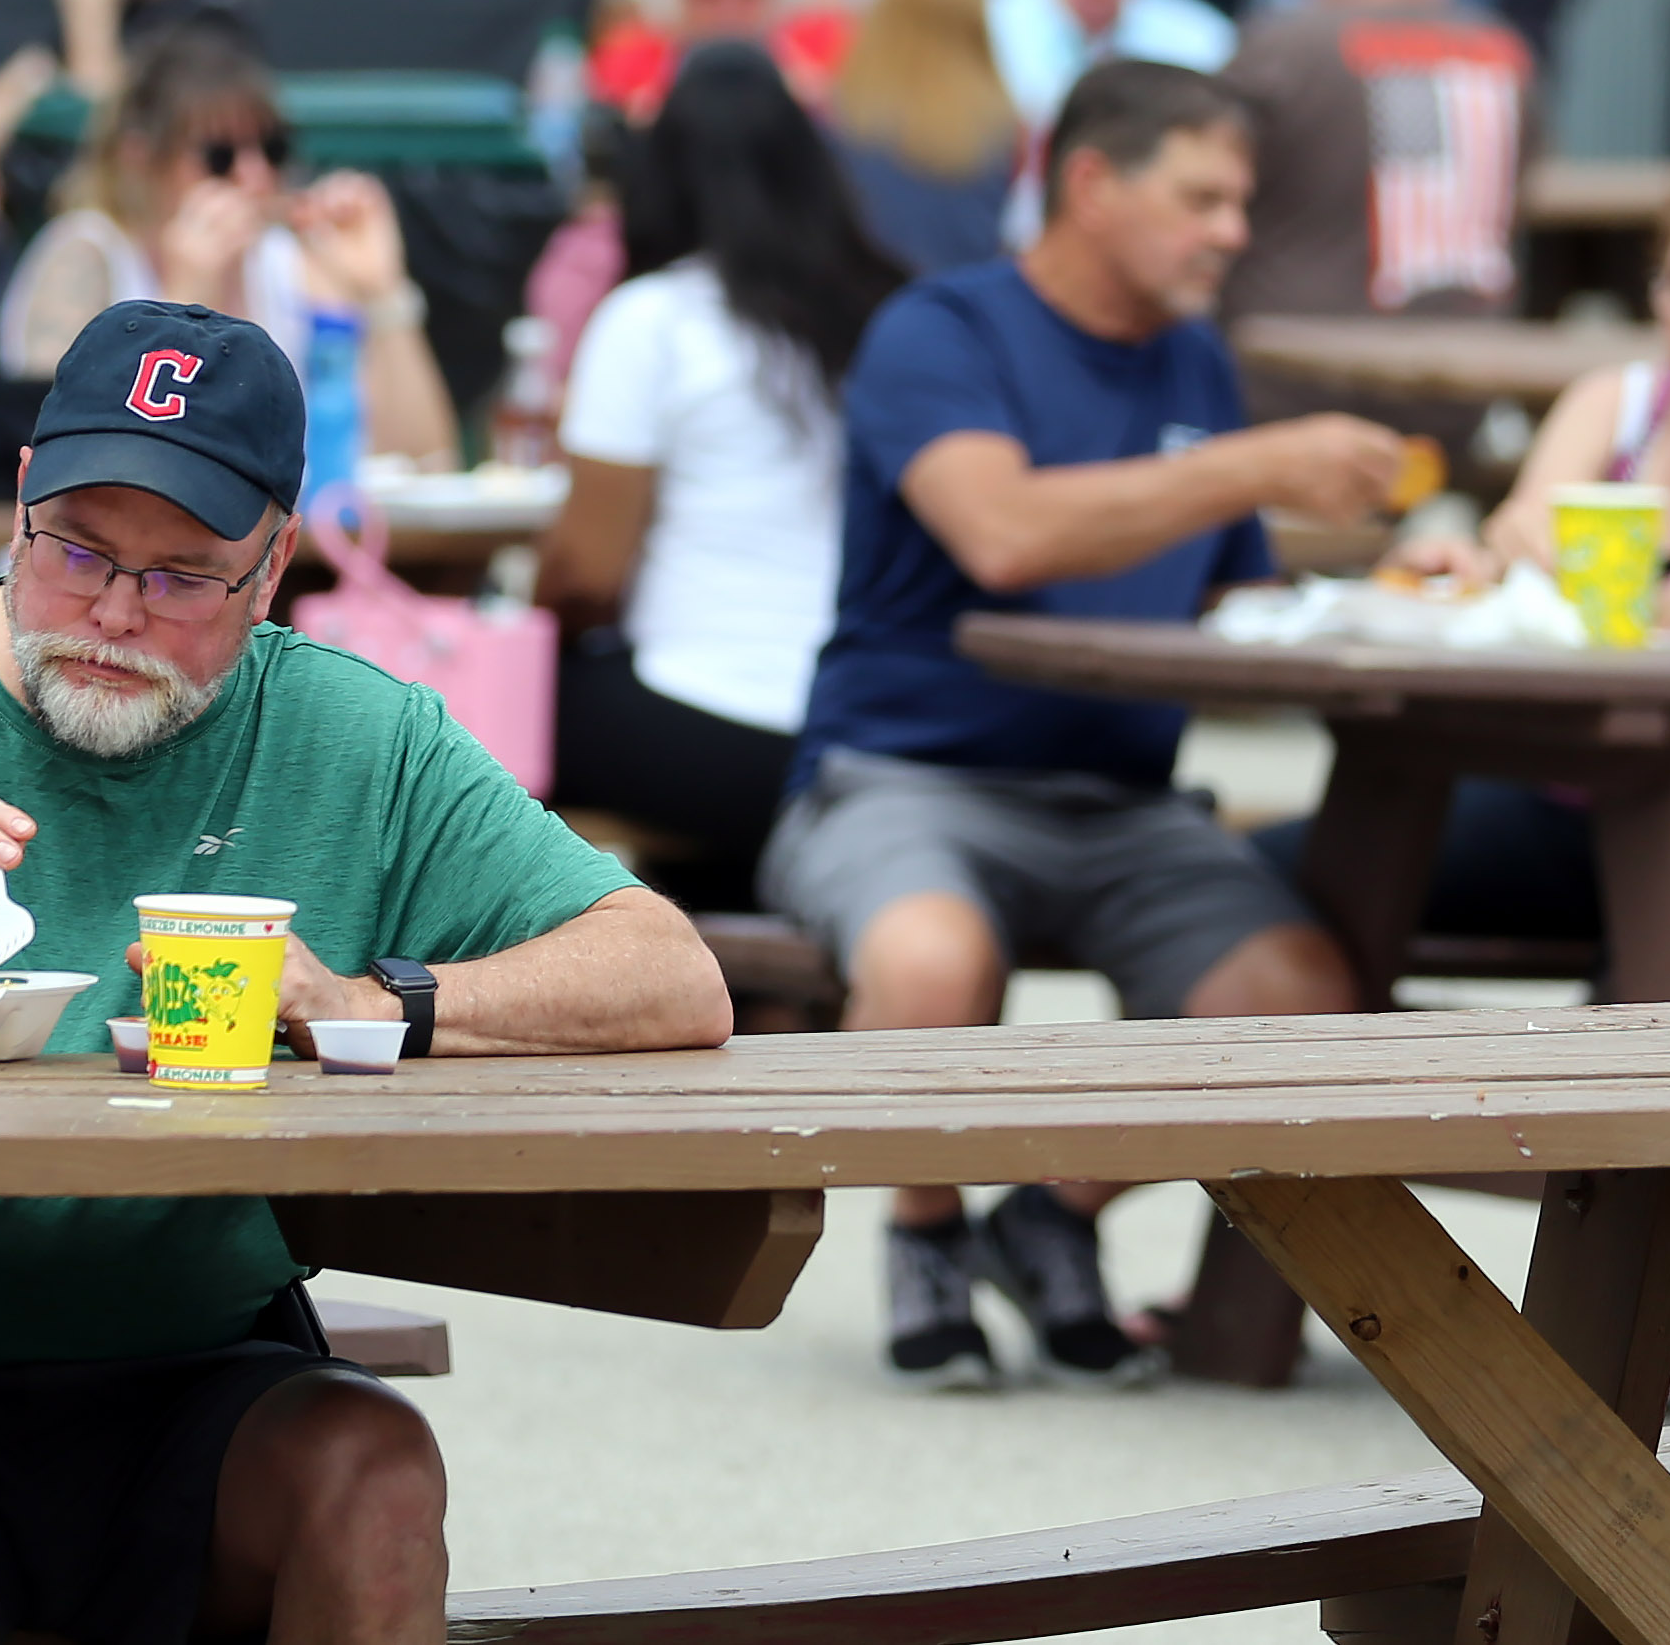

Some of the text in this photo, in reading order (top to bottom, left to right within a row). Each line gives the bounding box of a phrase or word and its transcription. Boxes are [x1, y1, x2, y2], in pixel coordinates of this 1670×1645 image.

[125, 348, 205, 422] C
[178, 920, 246, 935] LEMONADE
[157, 1067, 231, 1082] LEMONADE
